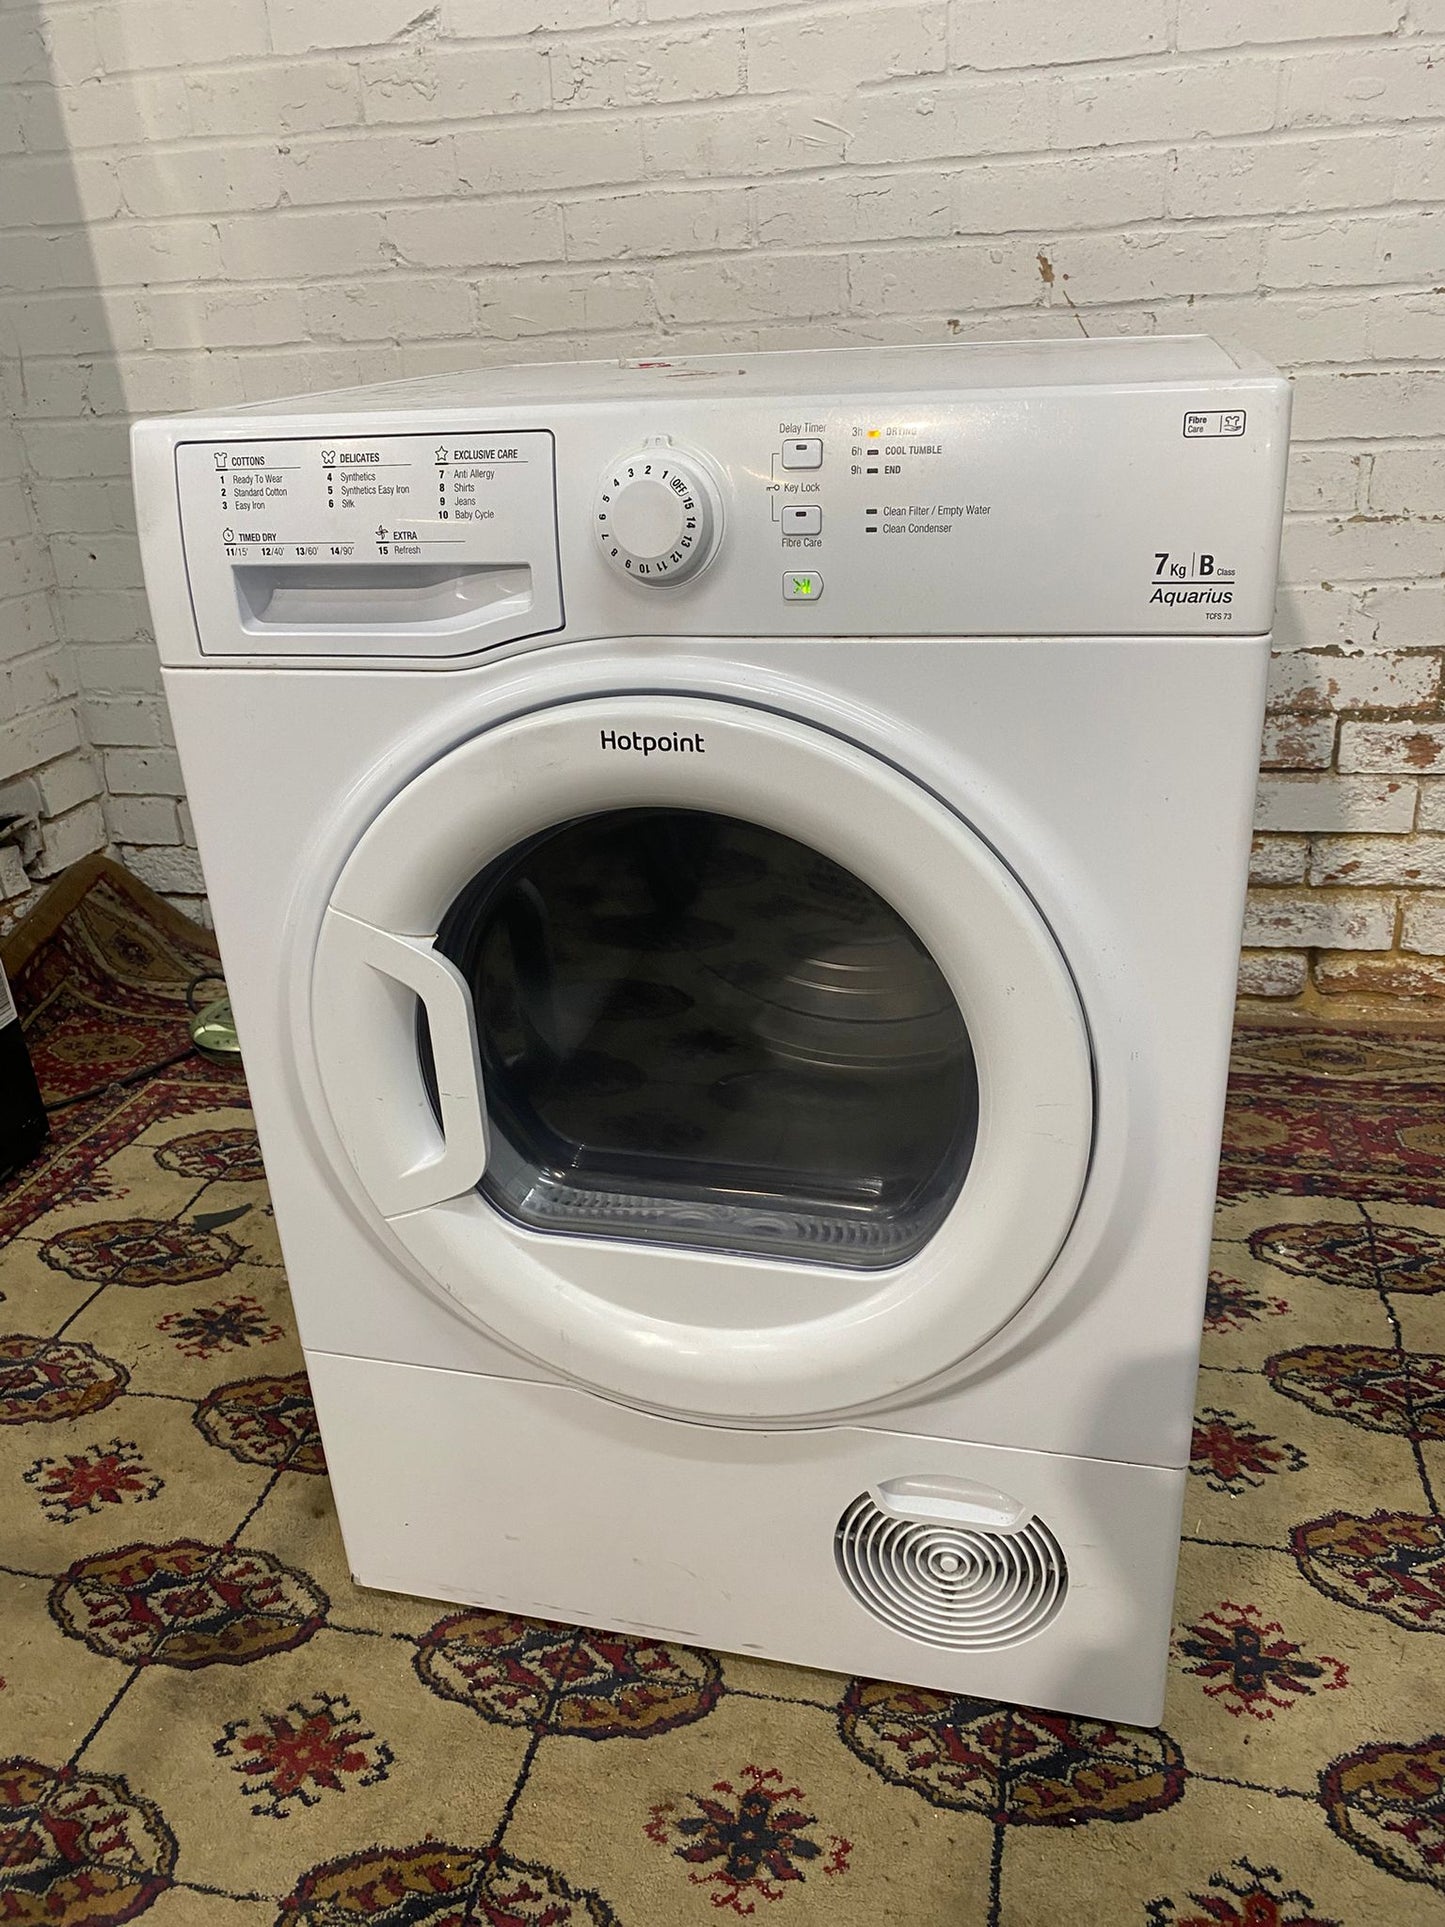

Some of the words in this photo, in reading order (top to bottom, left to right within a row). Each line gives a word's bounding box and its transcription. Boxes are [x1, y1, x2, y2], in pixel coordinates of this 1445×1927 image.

[1189, 416, 1207, 424] Fibre
[779, 423, 801, 434] Delay
[804, 422, 827, 432] Timer
[852, 427, 863, 437] 3h
[1188, 425, 1203, 433] Care
[454, 450, 495, 460] EXCLUSIVE
[497, 449, 518, 459] CARE
[852, 446, 862, 455] 6h
[885, 446, 906, 455] COOL
[909, 445, 942, 454] TUMBLE
[231, 456, 265, 466] COTTONS
[340, 453, 380, 463] DELICATES
[439, 470, 444, 478] 7
[454, 470, 468, 478] Anti
[470, 469, 494, 480] Allergy
[628, 468, 634, 477] 3
[644, 465, 651, 474] 2
[662, 470, 669, 479] 1
[851, 465, 862, 474] 9h
[884, 465, 901, 474] END
[220, 476, 224, 484] 1
[233, 475, 253, 485] Ready
[255, 475, 263, 483] To
[265, 475, 283, 483] Wear
[327, 473, 332, 481] 4
[340, 472, 376, 483] Synthetics
[613, 478, 620, 487] 4
[328, 486, 333, 494] 5
[341, 486, 376, 496] Synthetics
[378, 485, 394, 496] Easy
[396, 485, 410, 493] Iron
[439, 483, 444, 492] 8
[454, 483, 475, 492] Shirts
[672, 478, 688, 494] OFF
[784, 483, 799, 494] Key
[801, 483, 820, 492] Lock
[221, 488, 226, 496] 2
[234, 487, 264, 497] Standard
[265, 487, 287, 496] Cotton
[328, 500, 334, 508] 6
[342, 499, 355, 508] Silk
[440, 497, 445, 505] 9
[455, 497, 476, 505] Jeans
[602, 494, 610, 503] 5
[682, 496, 694, 510] 15
[222, 501, 227, 509] 3
[235, 501, 250, 511] Easy
[252, 501, 265, 509] Iron
[883, 507, 906, 516] Clean
[909, 506, 929, 516] Filter
[938, 506, 964, 517] Empty
[966, 505, 991, 515] Water
[439, 511, 448, 519] 10
[455, 510, 473, 520] Baby
[475, 510, 494, 520] Cycle
[686, 516, 696, 529] 14
[883, 524, 906, 534] Clean
[908, 524, 952, 533] Condenser
[239, 534, 260, 542] TIMED
[262, 533, 276, 541] DRY
[393, 531, 417, 540] EXTRA
[681, 535, 692, 548] 13
[782, 538, 801, 548] Fibre
[804, 538, 822, 547] Care
[379, 547, 388, 555] 15
[394, 546, 421, 554] Refresh
[611, 548, 618, 556] 8
[670, 551, 683, 563] 12
[625, 559, 631, 568] 9
[656, 561, 668, 571] 11
[1155, 553, 1169, 575] 7
[1170, 564, 1186, 579] Kg
[1200, 555, 1214, 575] B
[1217, 568, 1235, 576] Class
[639, 564, 650, 574] 10
[1149, 588, 1233, 607] Aquarius
[601, 730, 705, 756] Hotpoint
